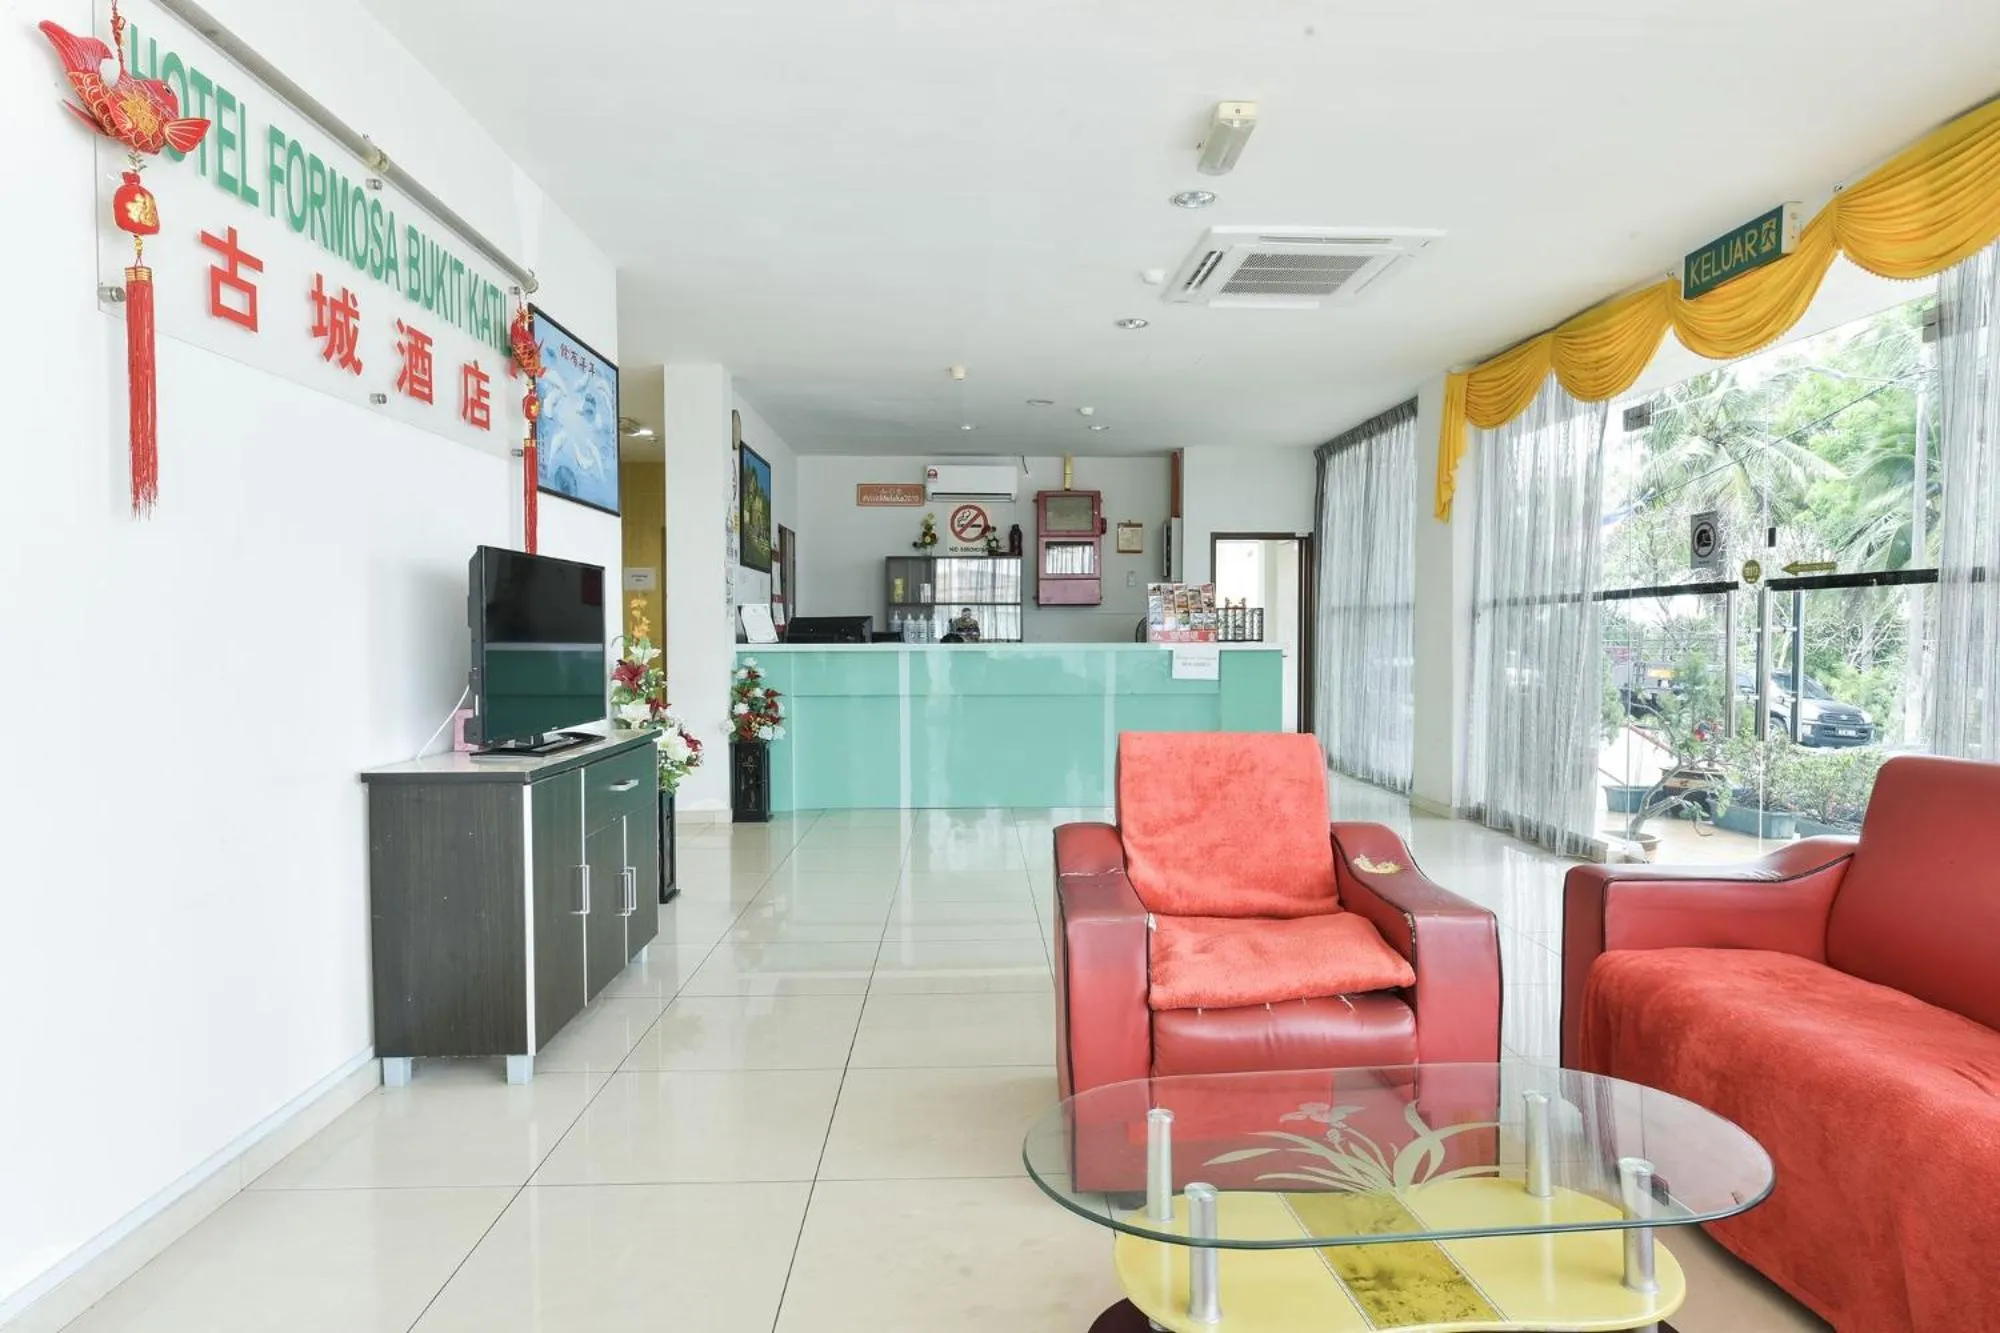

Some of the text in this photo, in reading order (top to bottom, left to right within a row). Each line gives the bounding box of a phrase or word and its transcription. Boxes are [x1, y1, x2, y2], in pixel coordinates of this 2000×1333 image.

[200, 225, 491, 431] 古城酒店
[269, 124, 401, 292] FORMOSA
[407, 225, 465, 329] BUKIT
[1690, 228, 1759, 289] KELUAR
